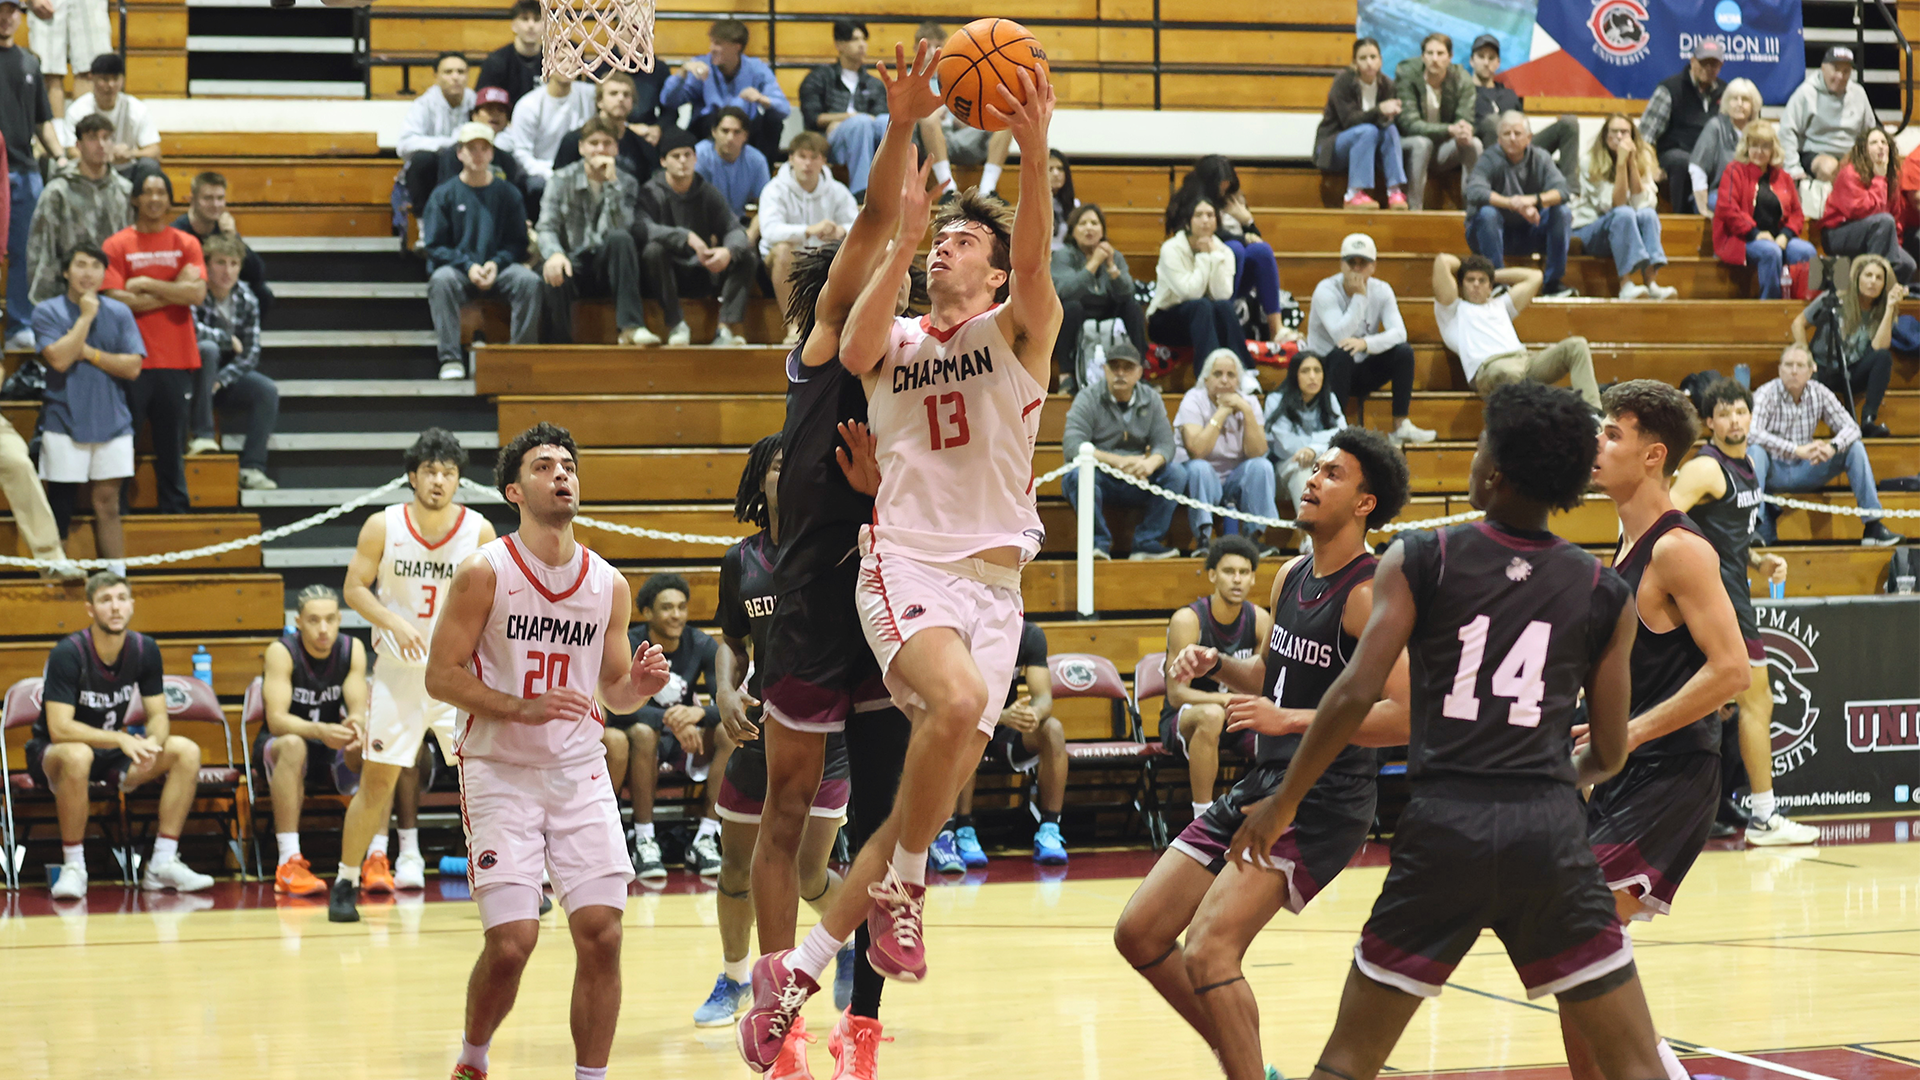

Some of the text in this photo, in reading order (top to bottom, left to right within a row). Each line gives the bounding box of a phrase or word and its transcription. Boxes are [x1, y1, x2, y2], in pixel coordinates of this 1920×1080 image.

[1765, 36, 1779, 54] III
[892, 345, 993, 394] CHAPMAN
[923, 391, 970, 451] 13
[394, 559, 458, 579] CHAPMA
[418, 585, 437, 618] 3
[507, 614, 598, 647] CHAPMAN
[523, 651, 571, 700] 20
[1442, 614, 1552, 728] 14
[1073, 746, 1139, 758] CHAPMAN
[1771, 733, 1818, 778] SITY
